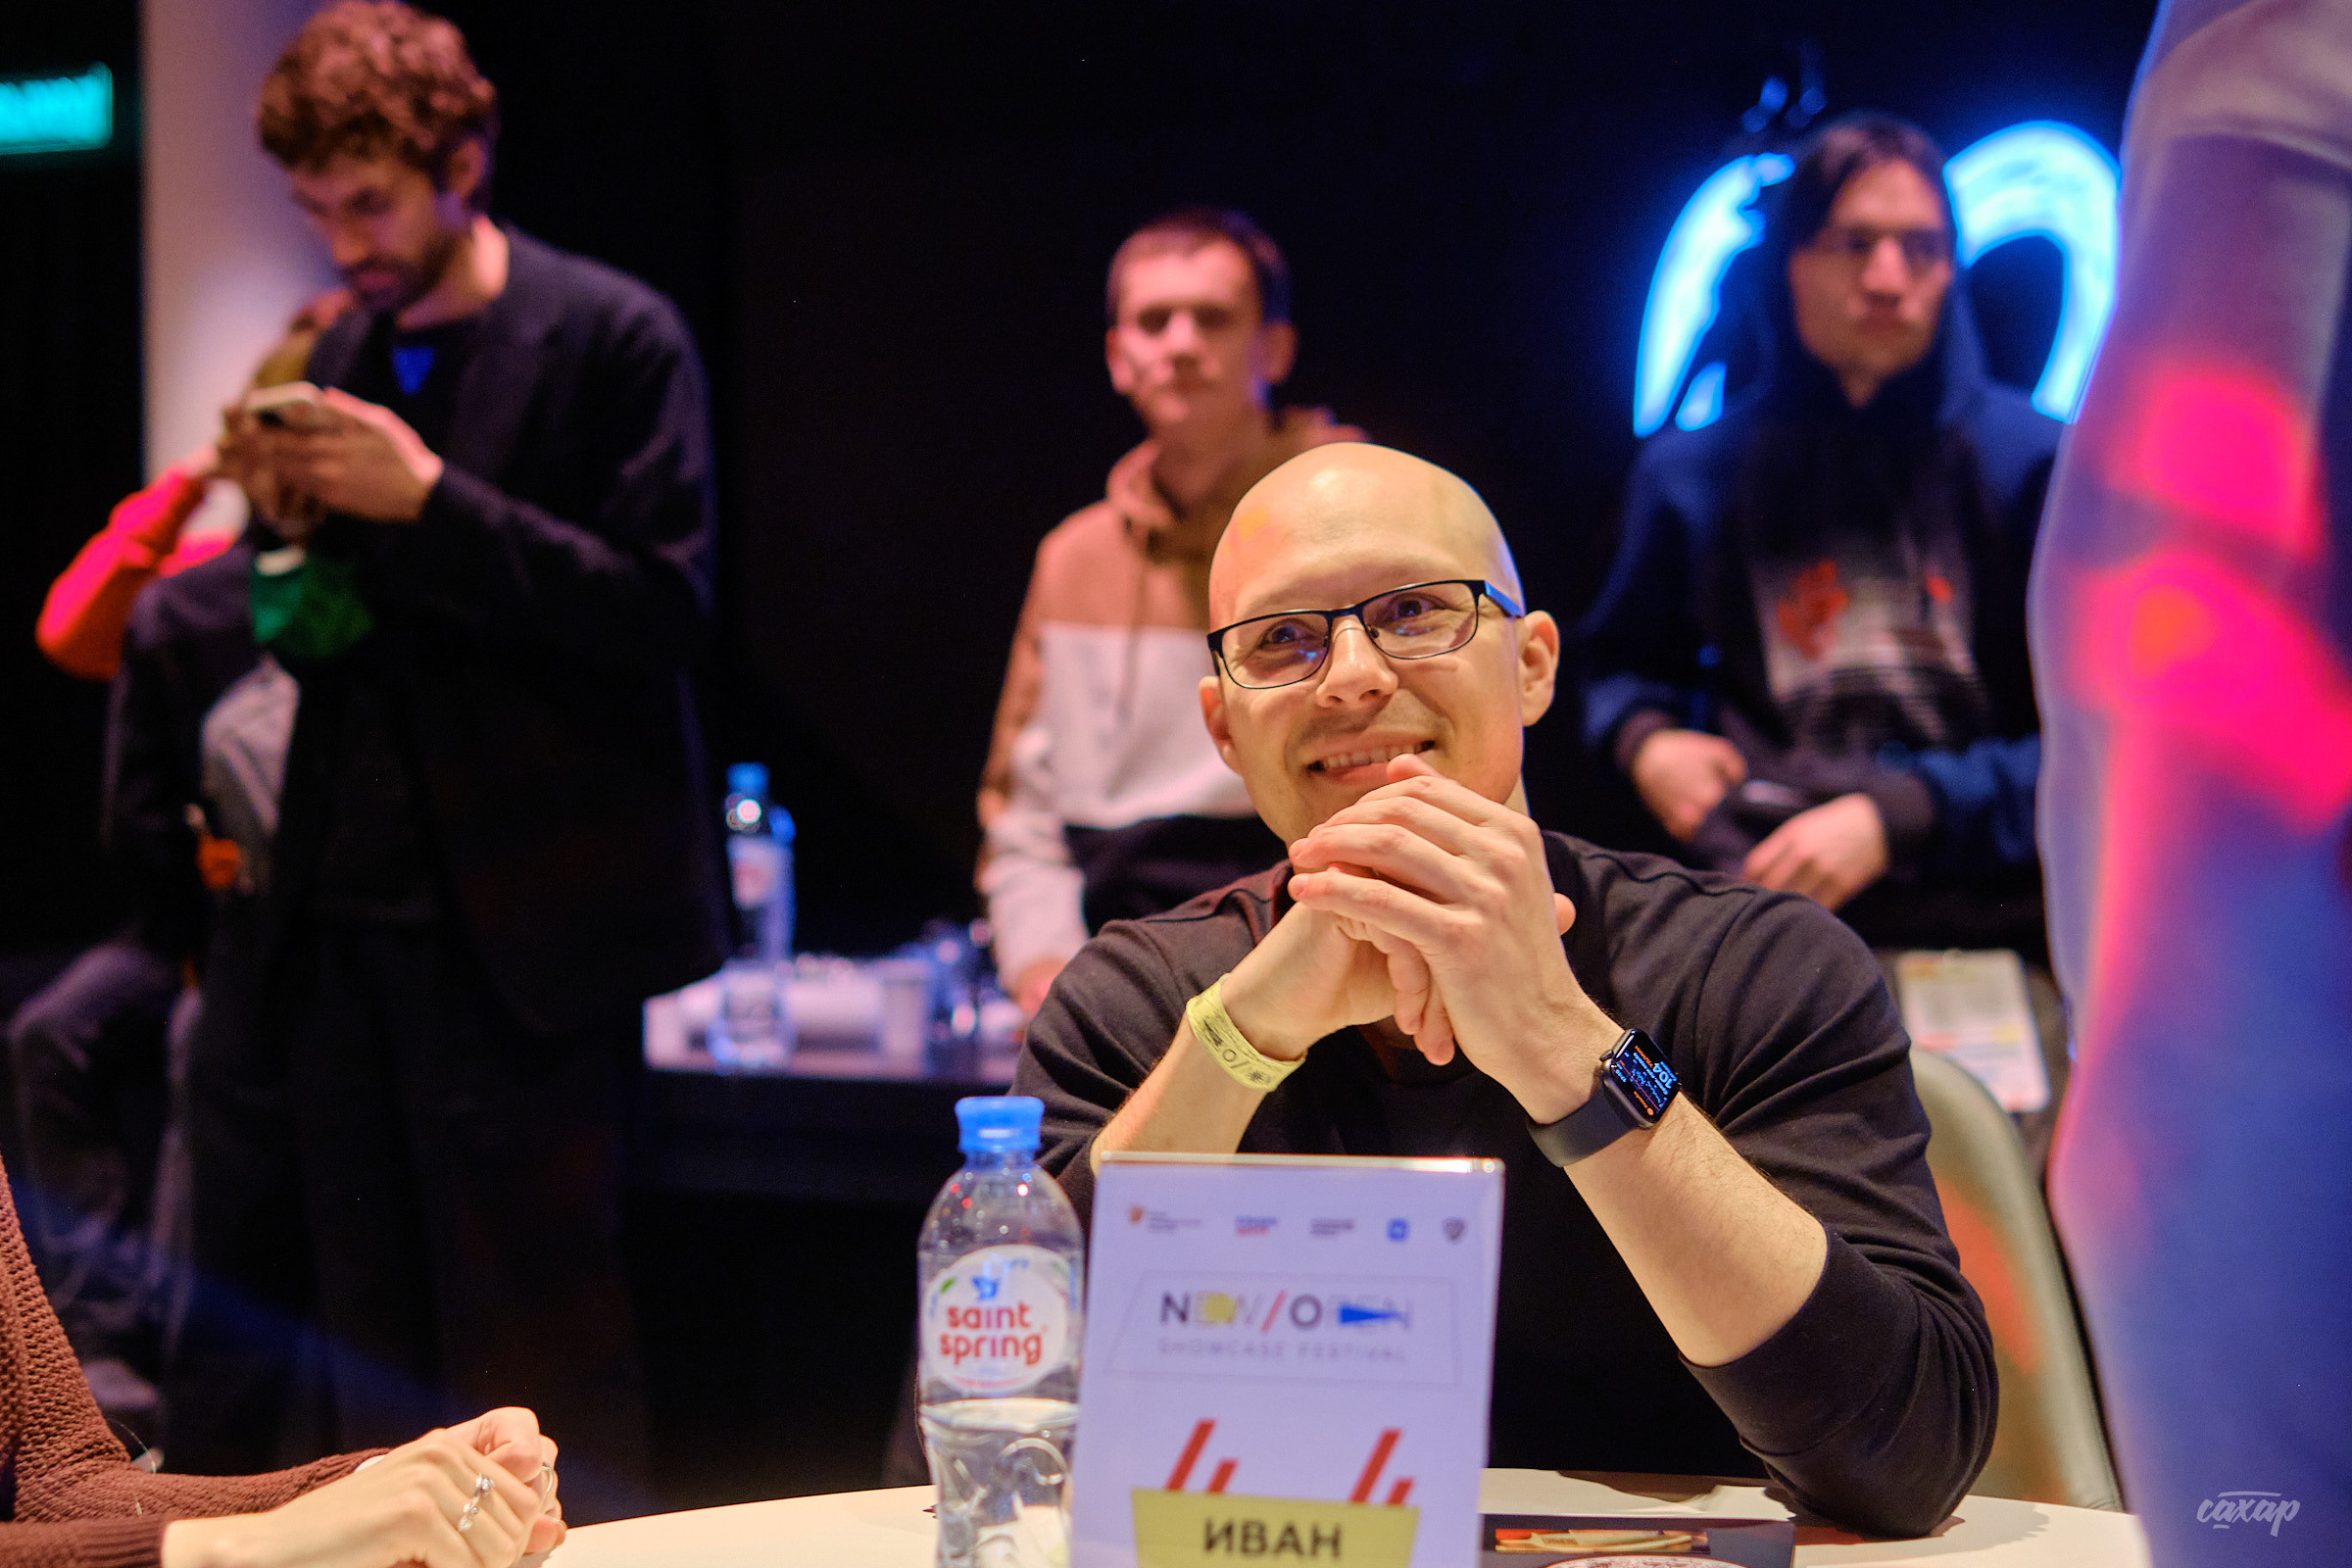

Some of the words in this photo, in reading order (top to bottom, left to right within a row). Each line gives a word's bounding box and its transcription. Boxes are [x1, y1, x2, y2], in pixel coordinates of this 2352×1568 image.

[1652, 1062, 1674, 1089] 104
[947, 1300, 1032, 1330] saint
[939, 1333, 1043, 1366] spring
[1157, 1337, 1285, 1358] SHOWCASE
[1297, 1341, 1406, 1363] FESTIVAL
[1202, 1516, 1344, 1559] ИВАН
